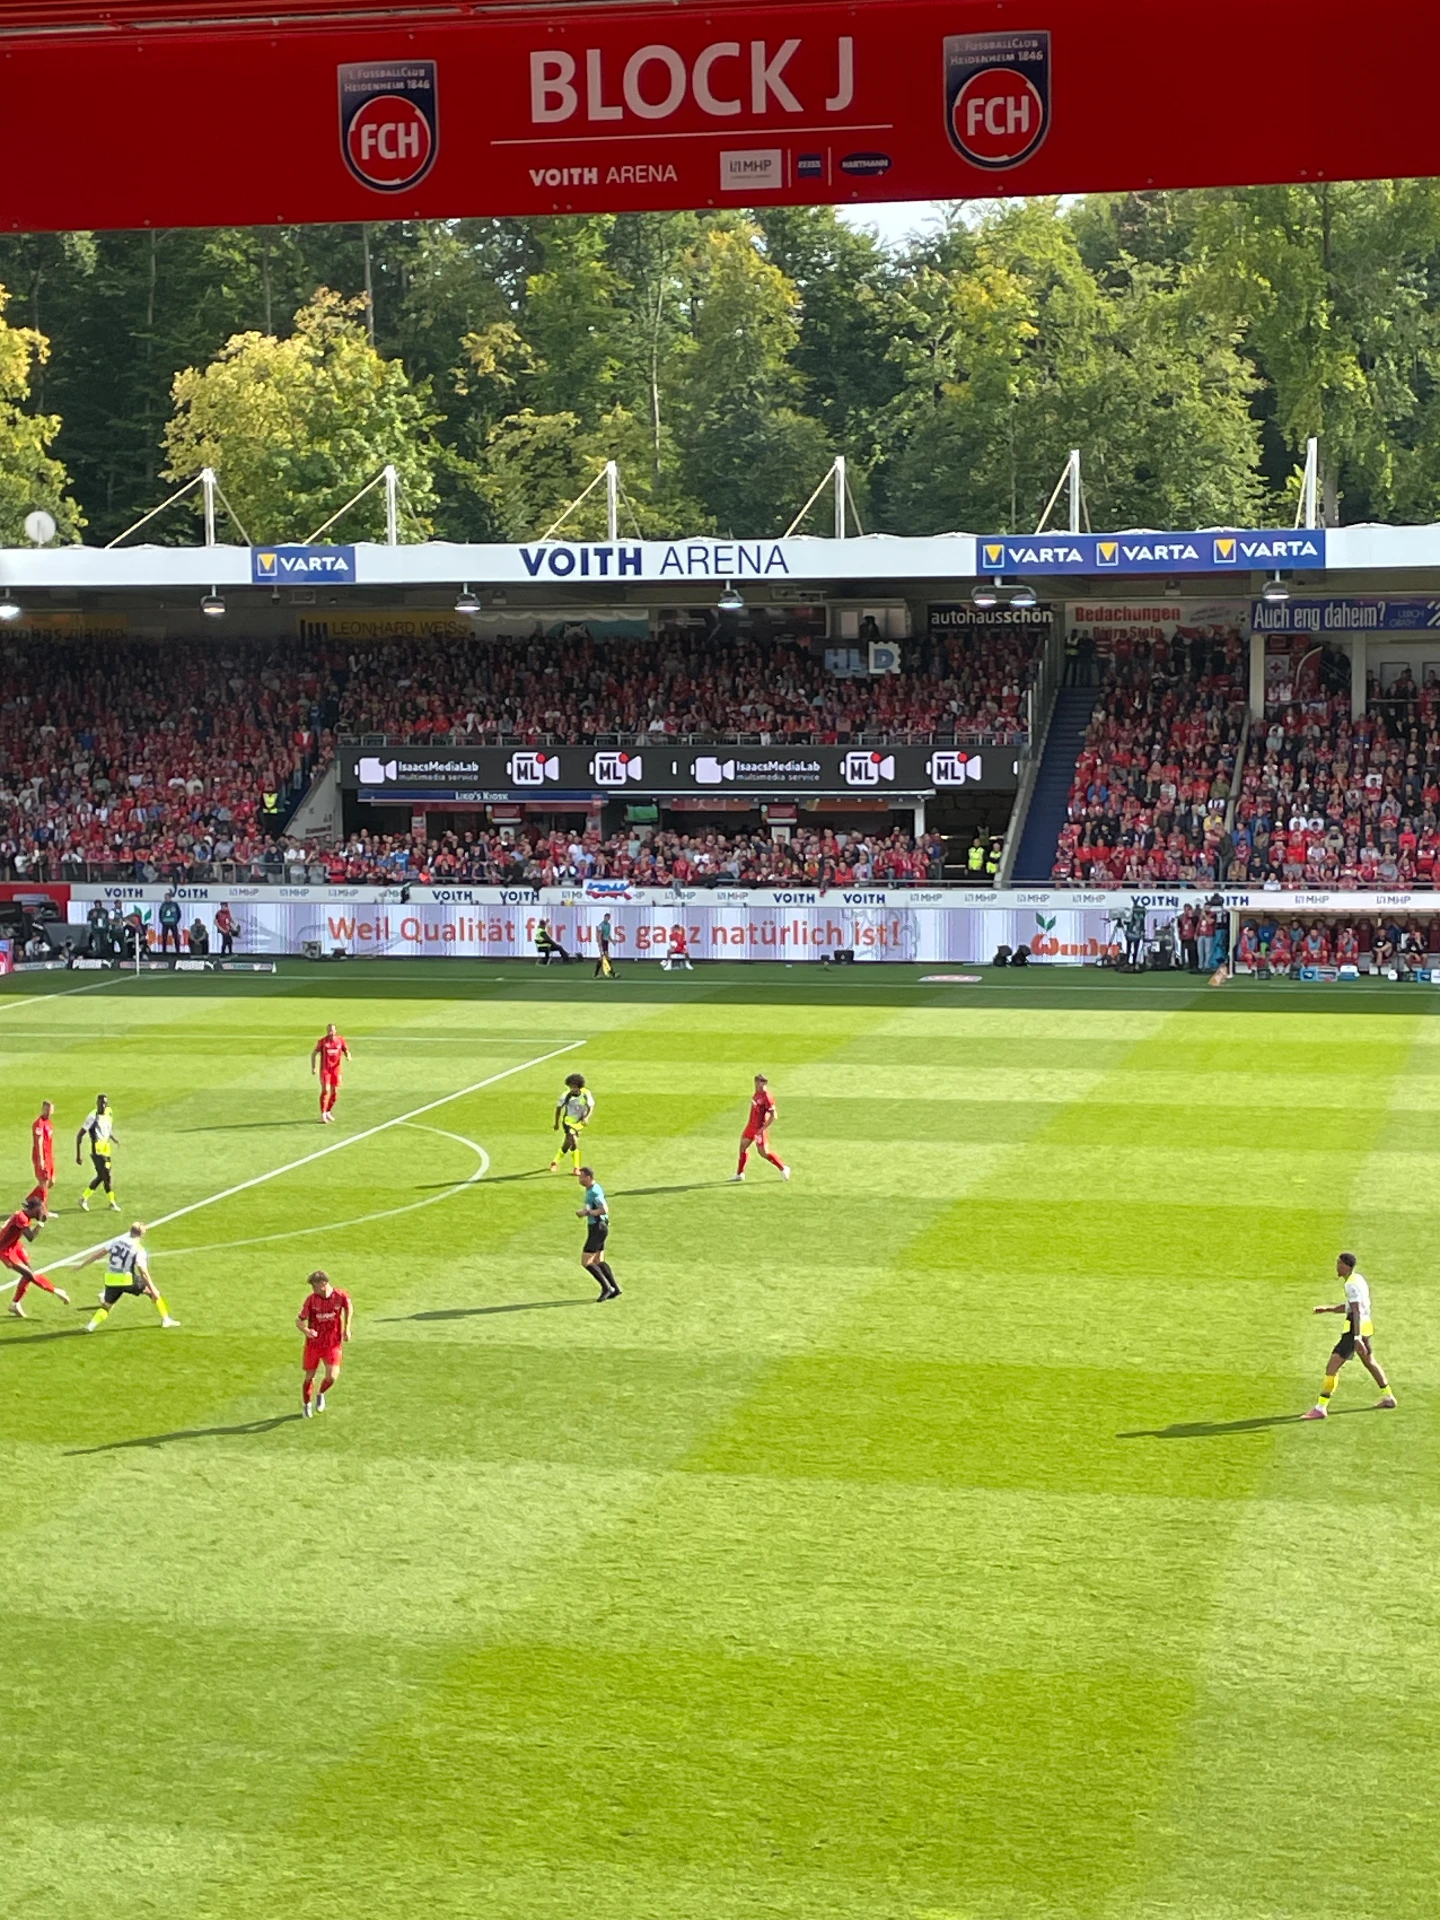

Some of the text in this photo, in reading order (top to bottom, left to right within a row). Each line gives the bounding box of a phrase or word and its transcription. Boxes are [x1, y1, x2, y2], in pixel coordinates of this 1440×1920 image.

[1018, 51, 1044, 61] 1846
[407, 79, 430, 89] 1846
[530, 36, 853, 123] BLOCK J
[966, 95, 1030, 136] FCH
[361, 122, 419, 160] FCH
[743, 159, 772, 172] MHP
[529, 164, 678, 187] VOITH ARENA
[1008, 547, 1083, 563] VARTA
[1122, 544, 1199, 561] VARTA
[1240, 540, 1318, 557] VARTA
[280, 556, 349, 571] VARTA
[519, 544, 790, 577] VOITH ARENA
[931, 604, 1053, 625] autohausschön
[1075, 606, 1181, 623] Bedachungen
[1253, 602, 1290, 629] Auch
[1294, 607, 1321, 632] eng
[1324, 600, 1386, 628] daheim?
[332, 620, 467, 635] LEONHARD WEISS
[398, 761, 479, 772] IsaacsMediaLab
[517, 762, 540, 780] ML
[600, 762, 622, 780] ML
[736, 761, 820, 771] IsaacsMediaLab
[850, 762, 874, 780] ML
[937, 762, 960, 780] ML
[104, 888, 143, 898] VOITH
[169, 888, 208, 899] VOITH
[432, 891, 472, 901] VOITH
[500, 891, 540, 901] VOITH
[773, 893, 815, 904] VOITH
[843, 894, 885, 904] VOITH
[328, 916, 389, 941] Weil
[401, 917, 515, 944] Qualität
[711, 919, 843, 946] natürlich
[855, 920, 901, 946] ist!
[110, 1245, 130, 1268] 24
